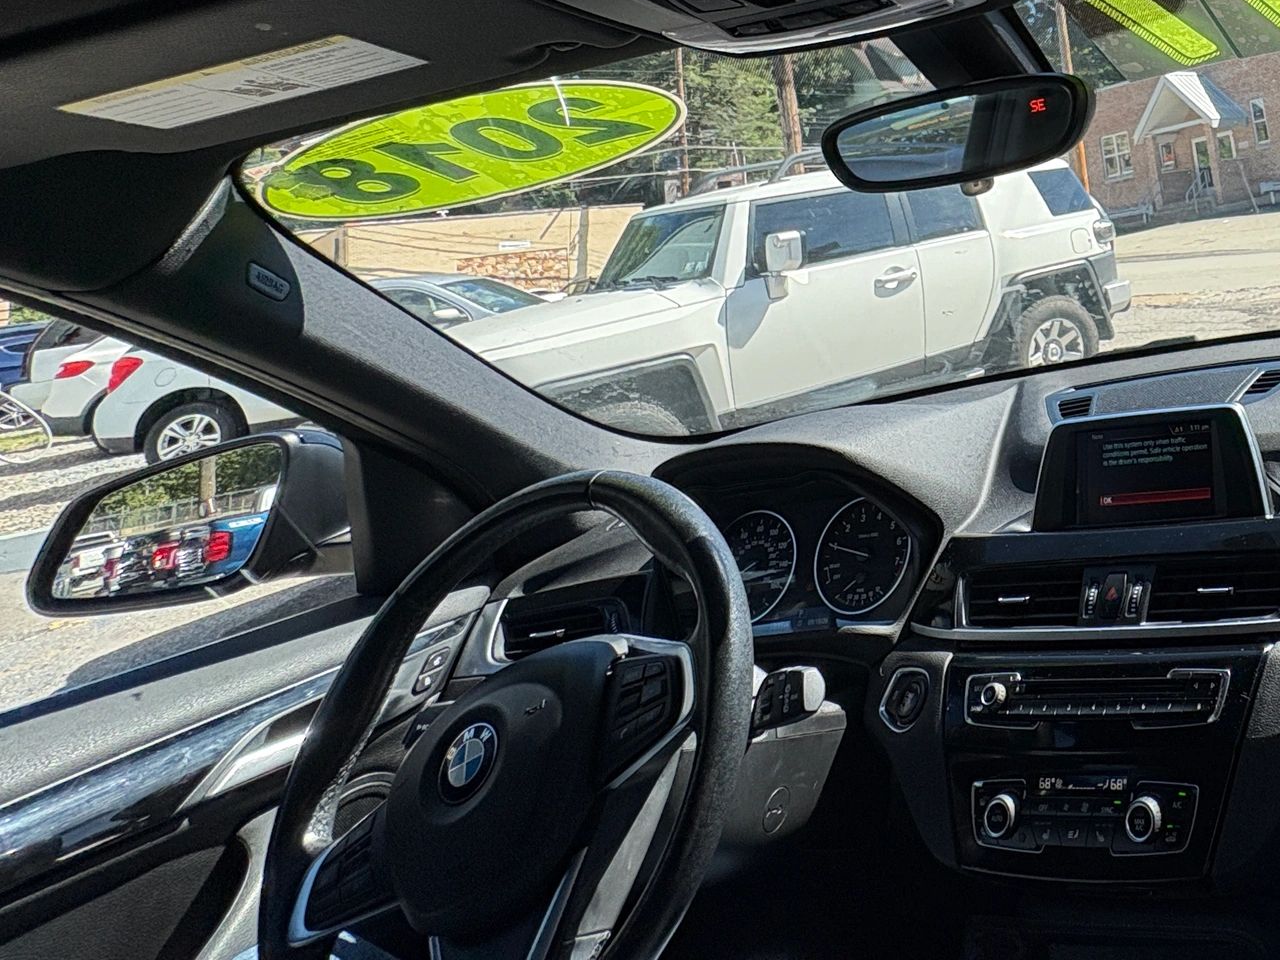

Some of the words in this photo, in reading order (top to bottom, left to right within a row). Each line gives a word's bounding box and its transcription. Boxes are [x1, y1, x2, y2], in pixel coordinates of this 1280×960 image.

[1029, 98, 1046, 113] SE
[1182, 444, 1208, 452] operation
[1103, 496, 1112, 504] OK
[861, 514, 866, 522] 3
[446, 727, 492, 761] BMW
